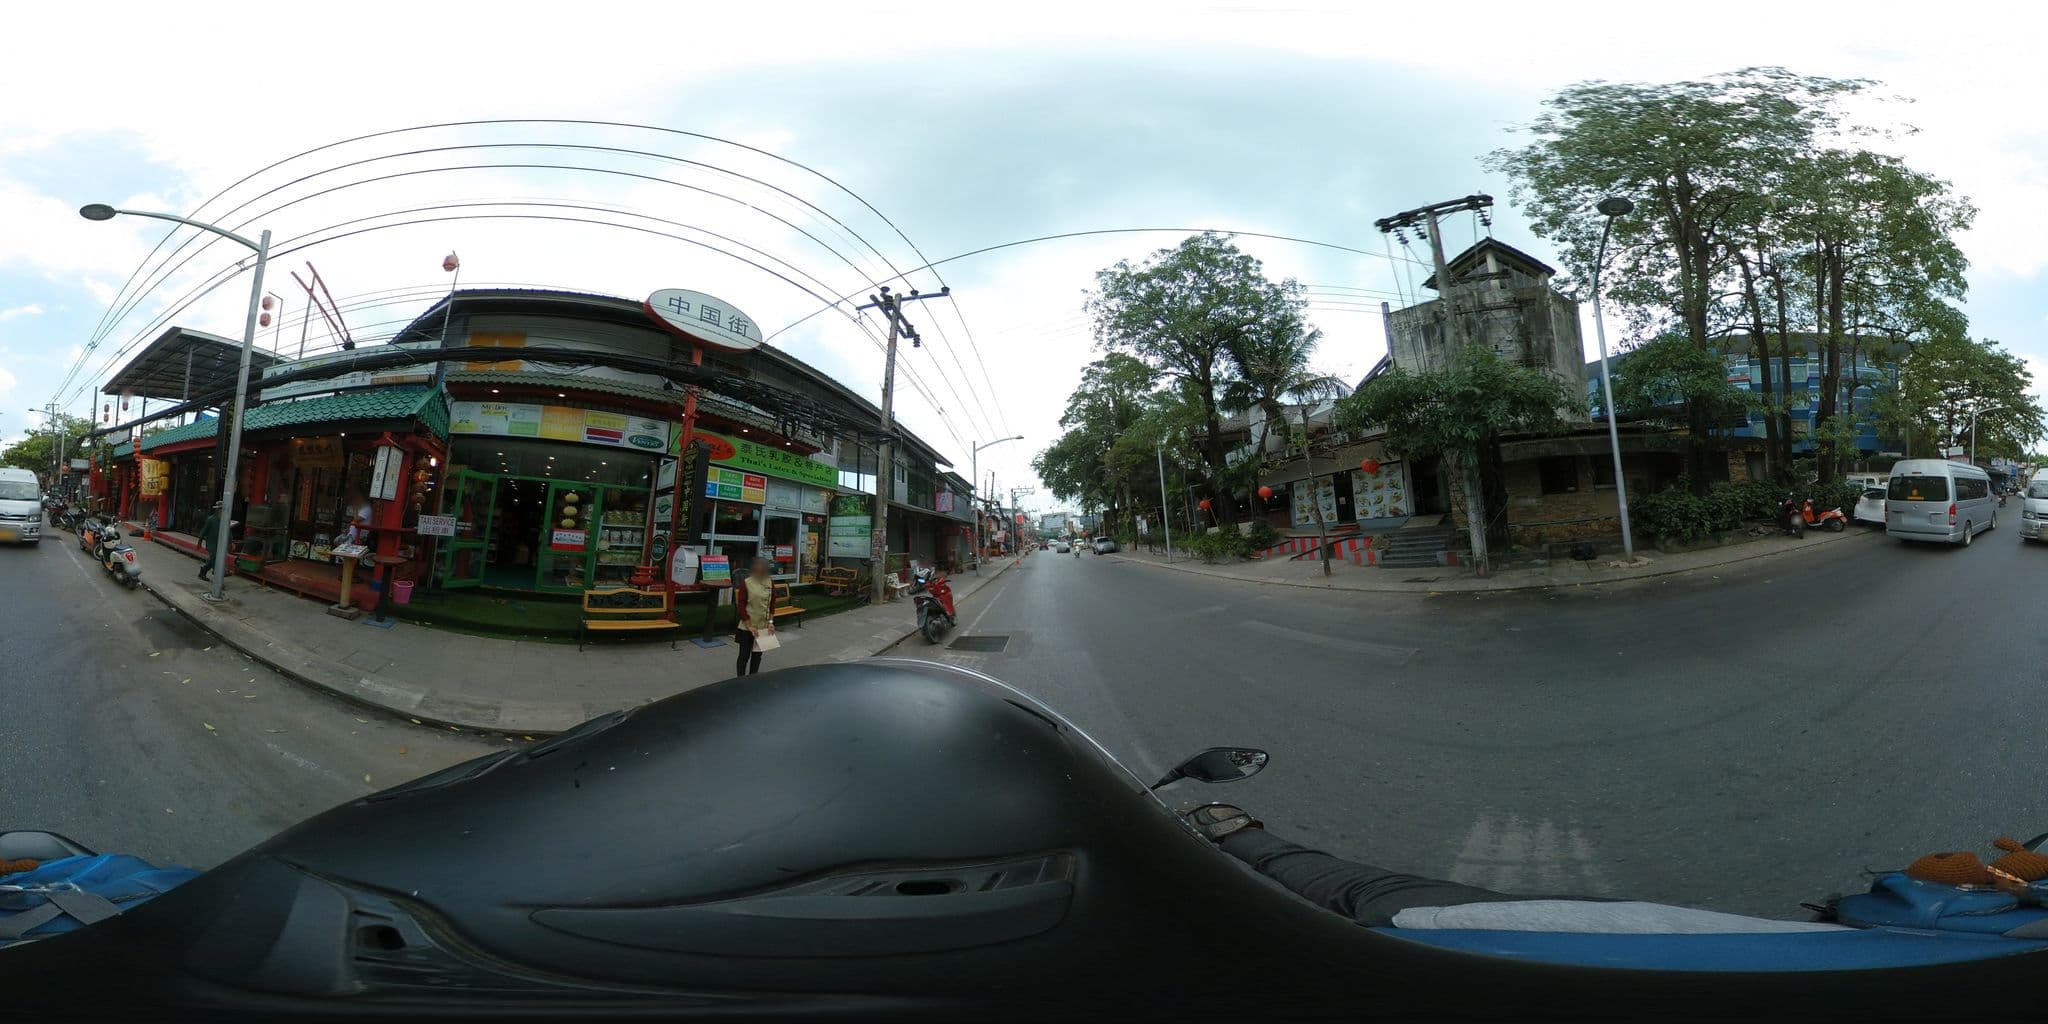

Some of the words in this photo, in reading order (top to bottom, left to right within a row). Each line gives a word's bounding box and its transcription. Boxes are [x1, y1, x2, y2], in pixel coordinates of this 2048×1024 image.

[668, 296, 749, 337] 中国街
[741, 456, 767, 468] Thai's
[420, 516, 432, 525] TAXI
[432, 517, 455, 527] SERVICE
